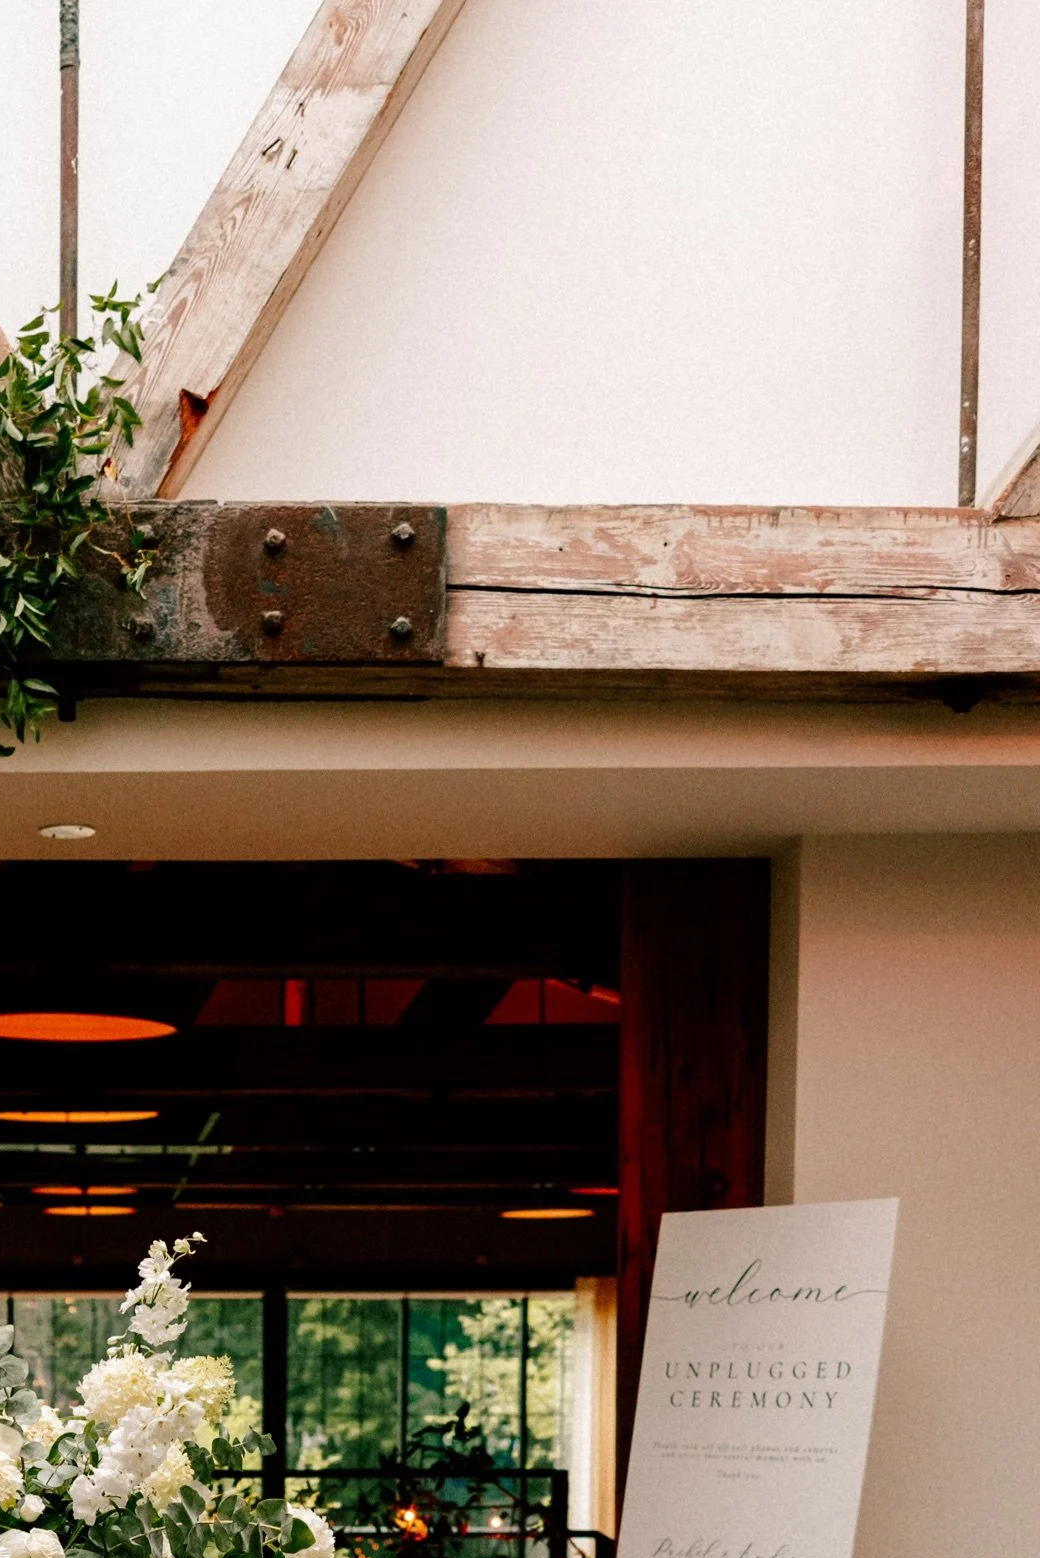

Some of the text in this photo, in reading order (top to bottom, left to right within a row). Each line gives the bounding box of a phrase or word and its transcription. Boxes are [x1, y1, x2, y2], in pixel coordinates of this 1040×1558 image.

[651, 1258, 888, 1307] welcome
[664, 1361, 852, 1379] UNPLUGGED
[669, 1390, 839, 1409] CEREMONY
